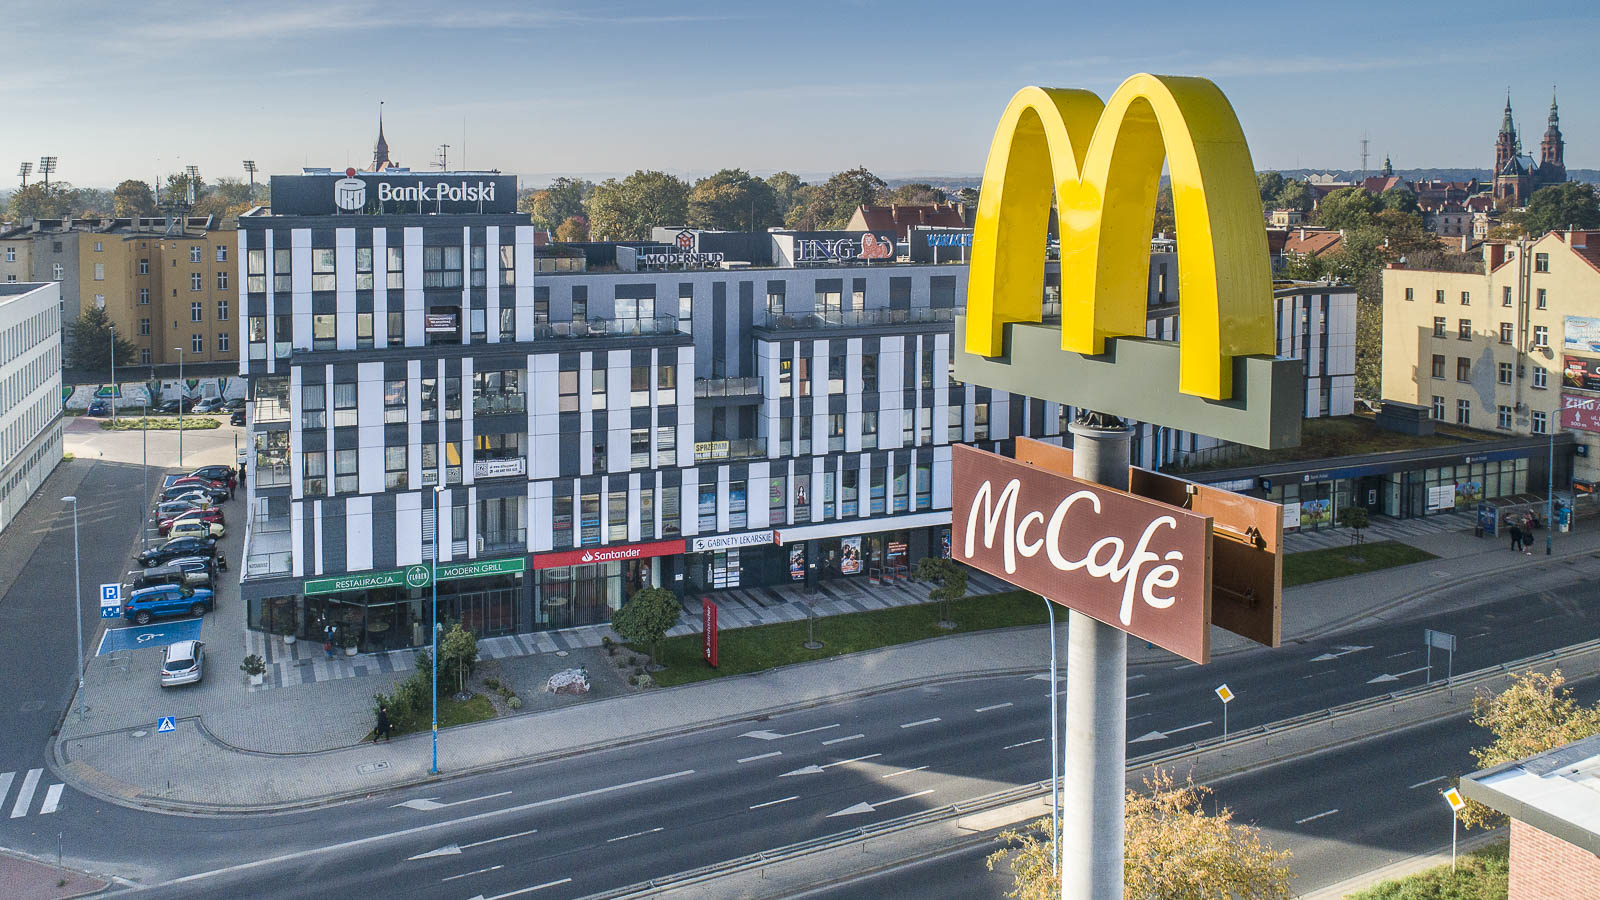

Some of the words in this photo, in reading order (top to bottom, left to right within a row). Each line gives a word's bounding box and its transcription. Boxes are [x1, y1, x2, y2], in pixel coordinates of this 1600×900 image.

[378, 181, 431, 202] Bank
[437, 181, 496, 202] Polski
[797, 238, 856, 260] ING
[646, 253, 723, 264] MODERNBUD
[707, 537, 738, 548] GABINETY
[739, 533, 772, 545] LEKARSKIE
[594, 548, 641, 561] Santander
[964, 478, 1184, 626] McCafé
[444, 565, 480, 577] MODERN
[481, 563, 503, 573] GRILL
[335, 576, 394, 589] RESTAURACJA
[106, 587, 116, 599] P
